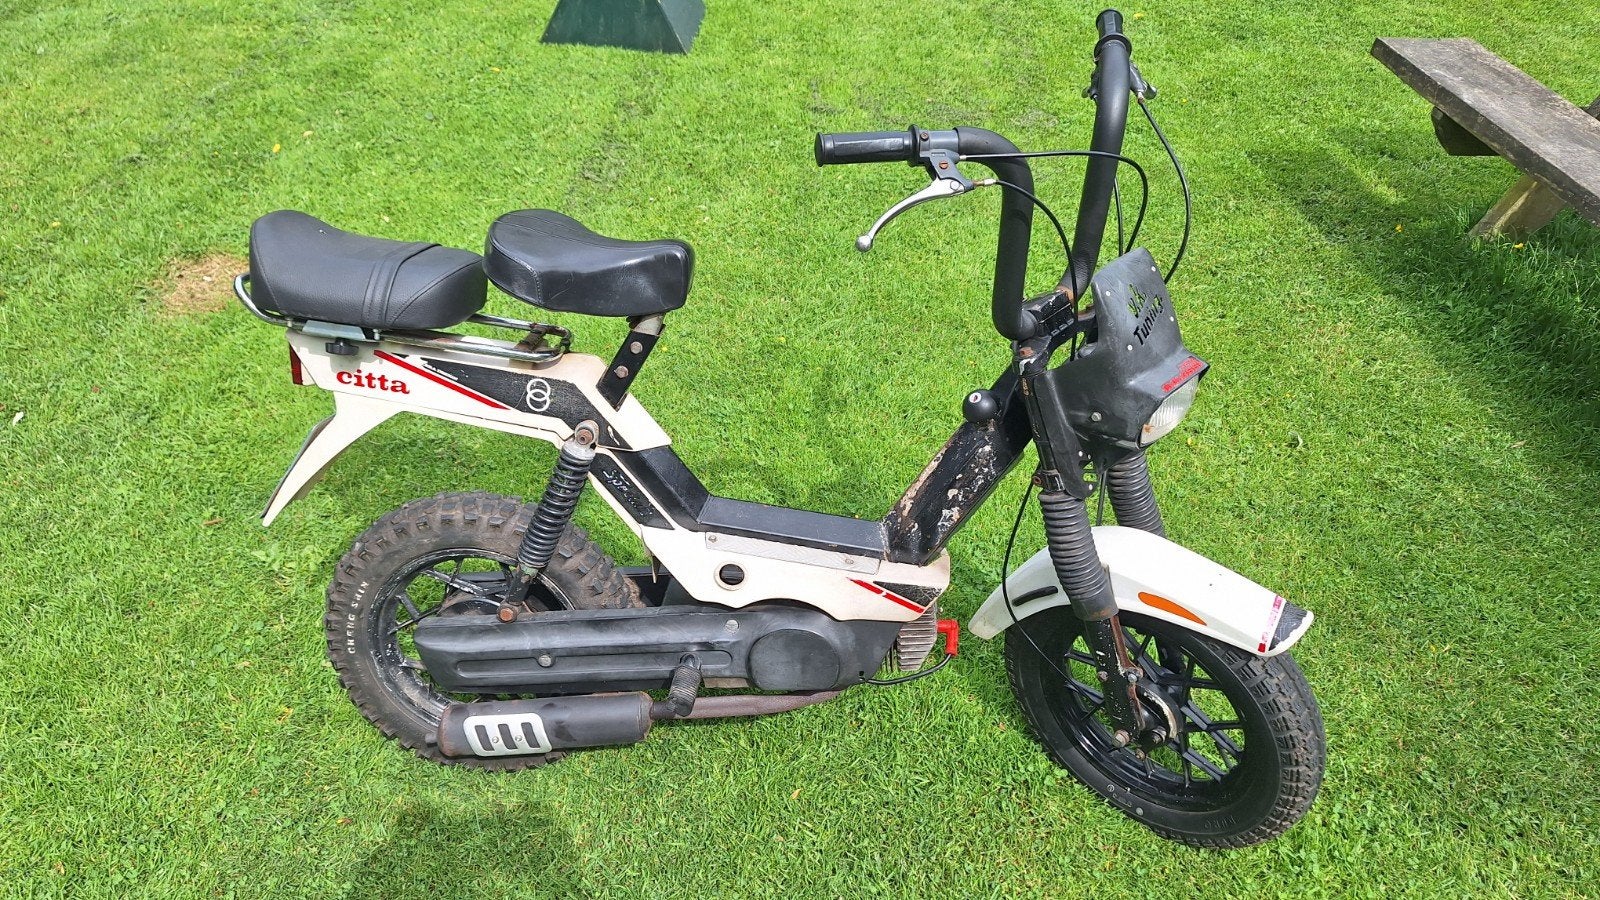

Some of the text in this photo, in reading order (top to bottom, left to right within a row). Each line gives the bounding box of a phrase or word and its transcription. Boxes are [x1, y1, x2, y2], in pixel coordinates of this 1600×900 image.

[1133, 294, 1163, 345] Tuning
[336, 368, 411, 395] citta
[346, 581, 370, 654] CHENG SHIN
